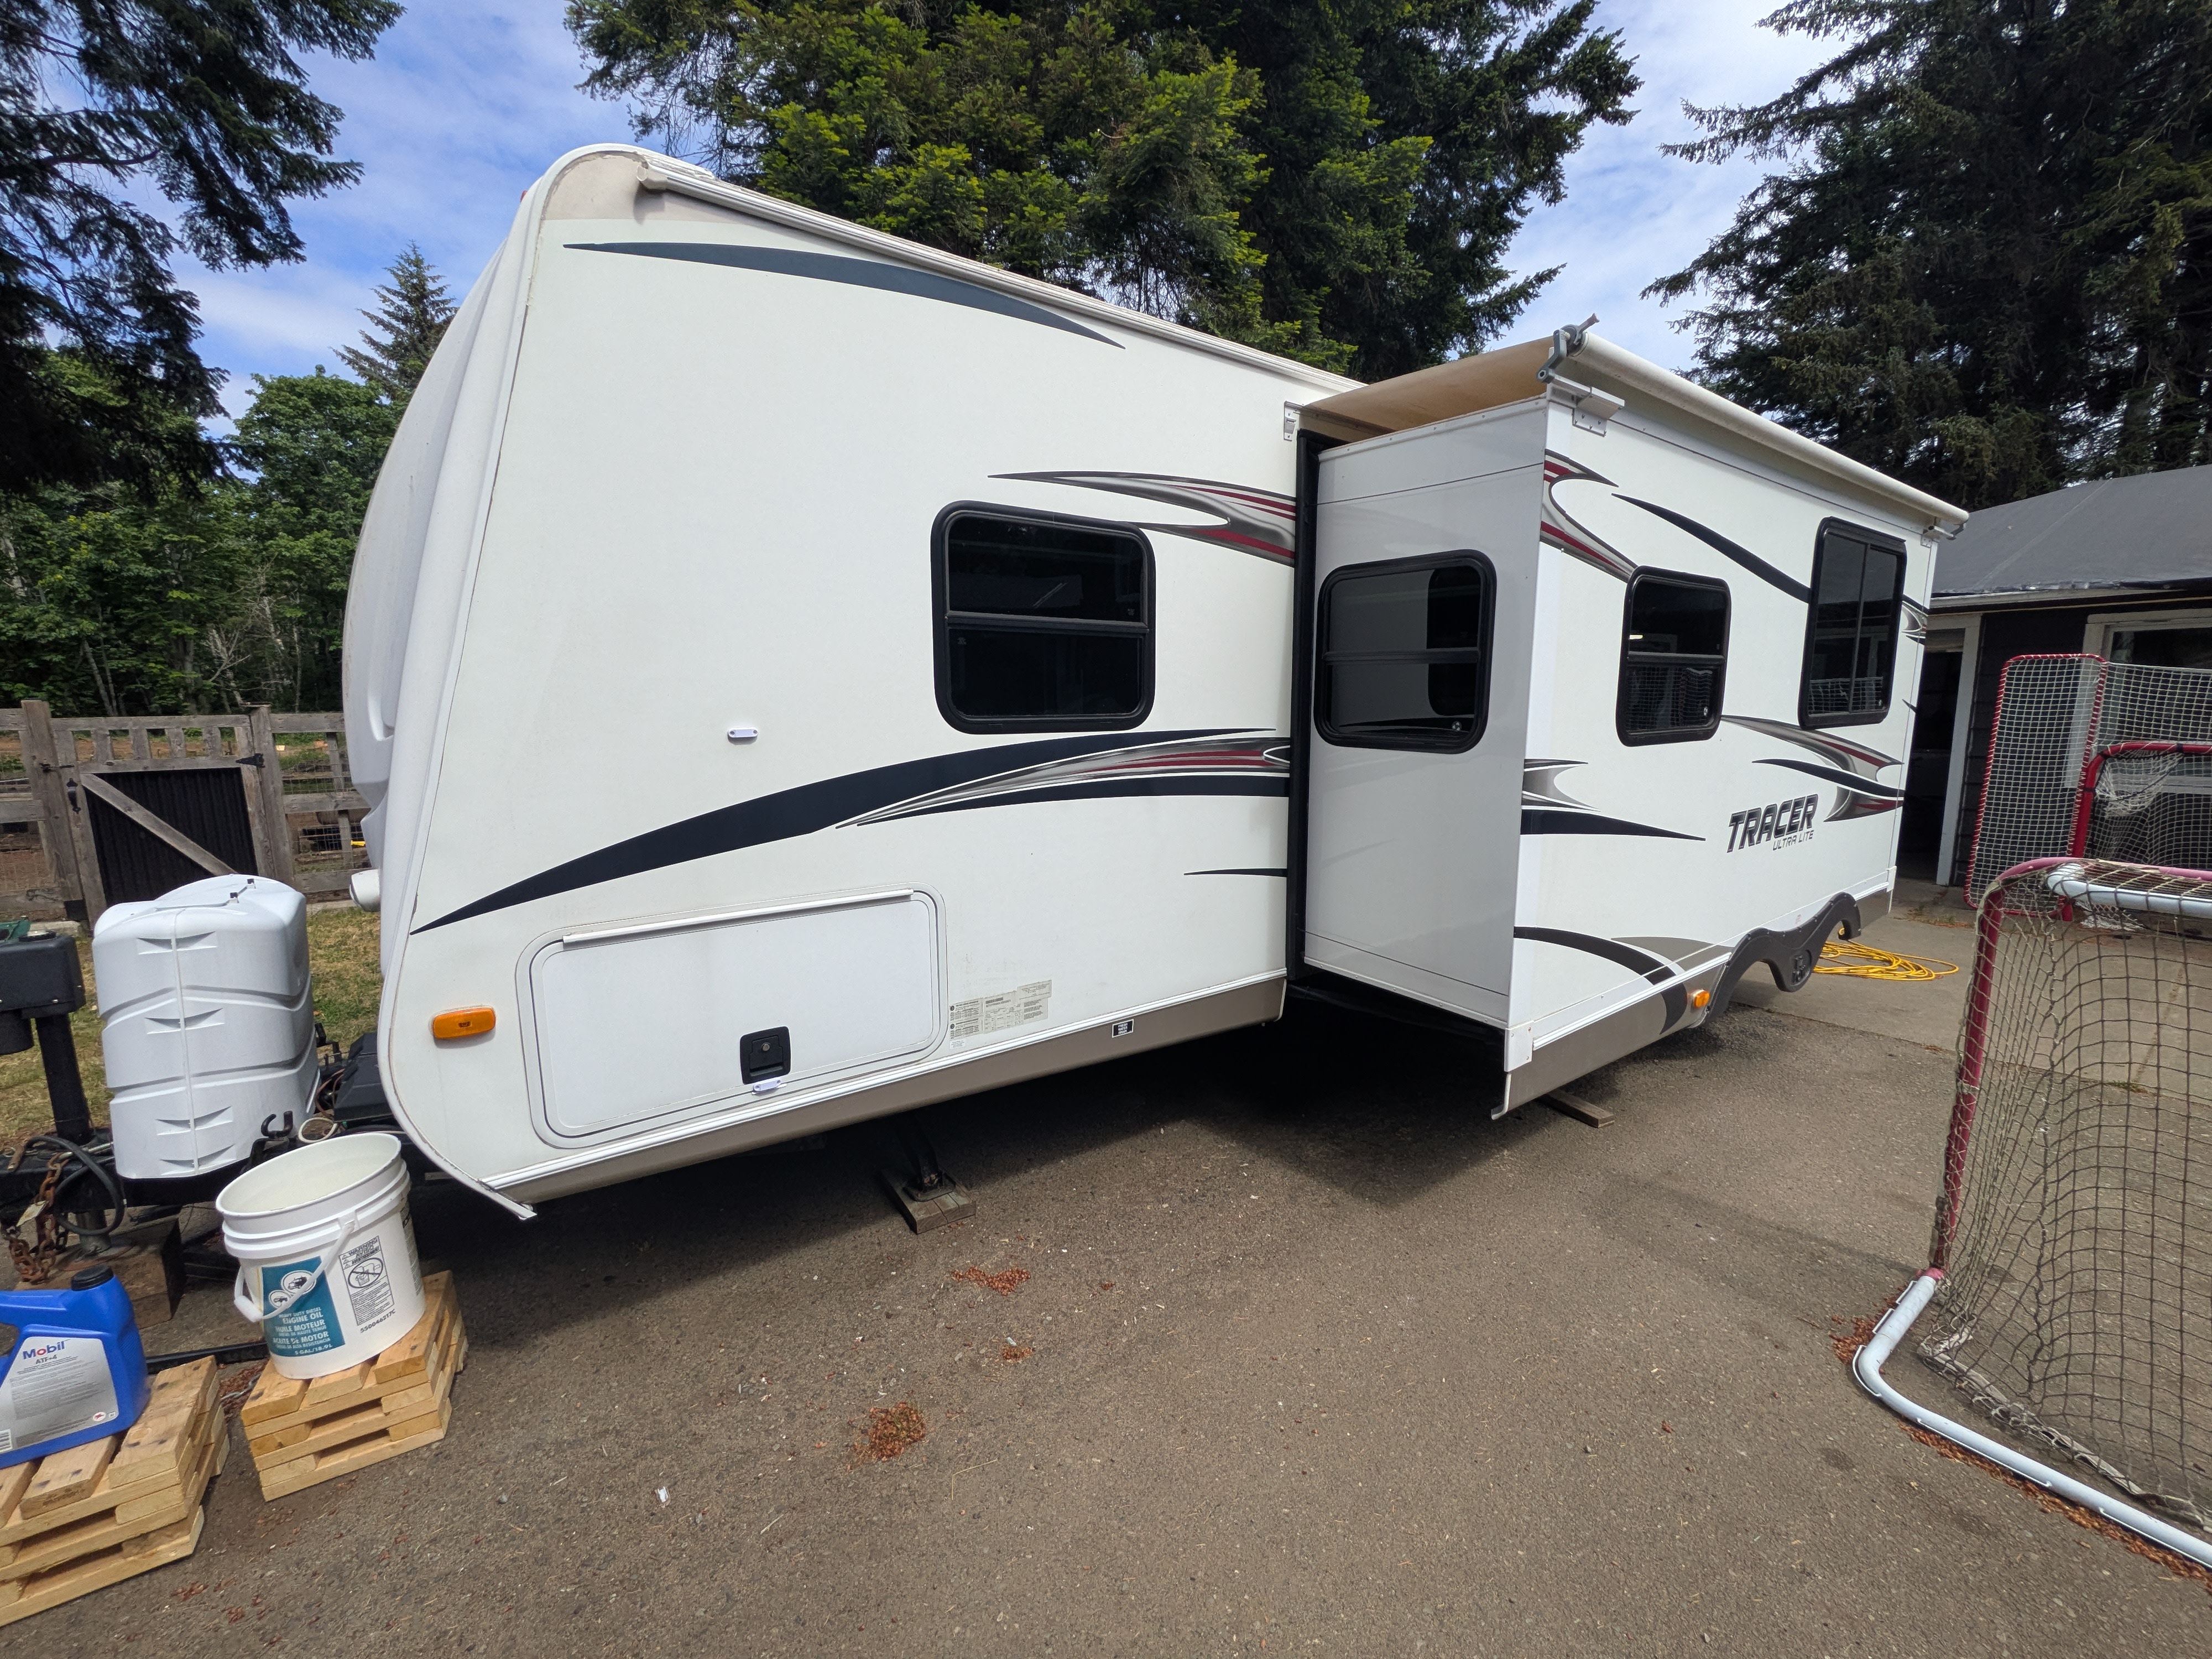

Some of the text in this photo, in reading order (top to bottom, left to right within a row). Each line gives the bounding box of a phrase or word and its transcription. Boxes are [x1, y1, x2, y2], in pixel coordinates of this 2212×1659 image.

[1726, 794, 1819, 853] TRACER
[1772, 830, 1814, 851] ULTRA LITE
[348, 1238, 378, 1256] WARNING
[356, 1244, 374, 1258] AVISO
[283, 1311, 324, 1324] ENGINE OIL
[294, 1319, 326, 1332] MOTEUR
[360, 1308, 396, 1333] 550046217C
[301, 1331, 329, 1343] MOTOR
[22, 1341, 65, 1360] Mobil
